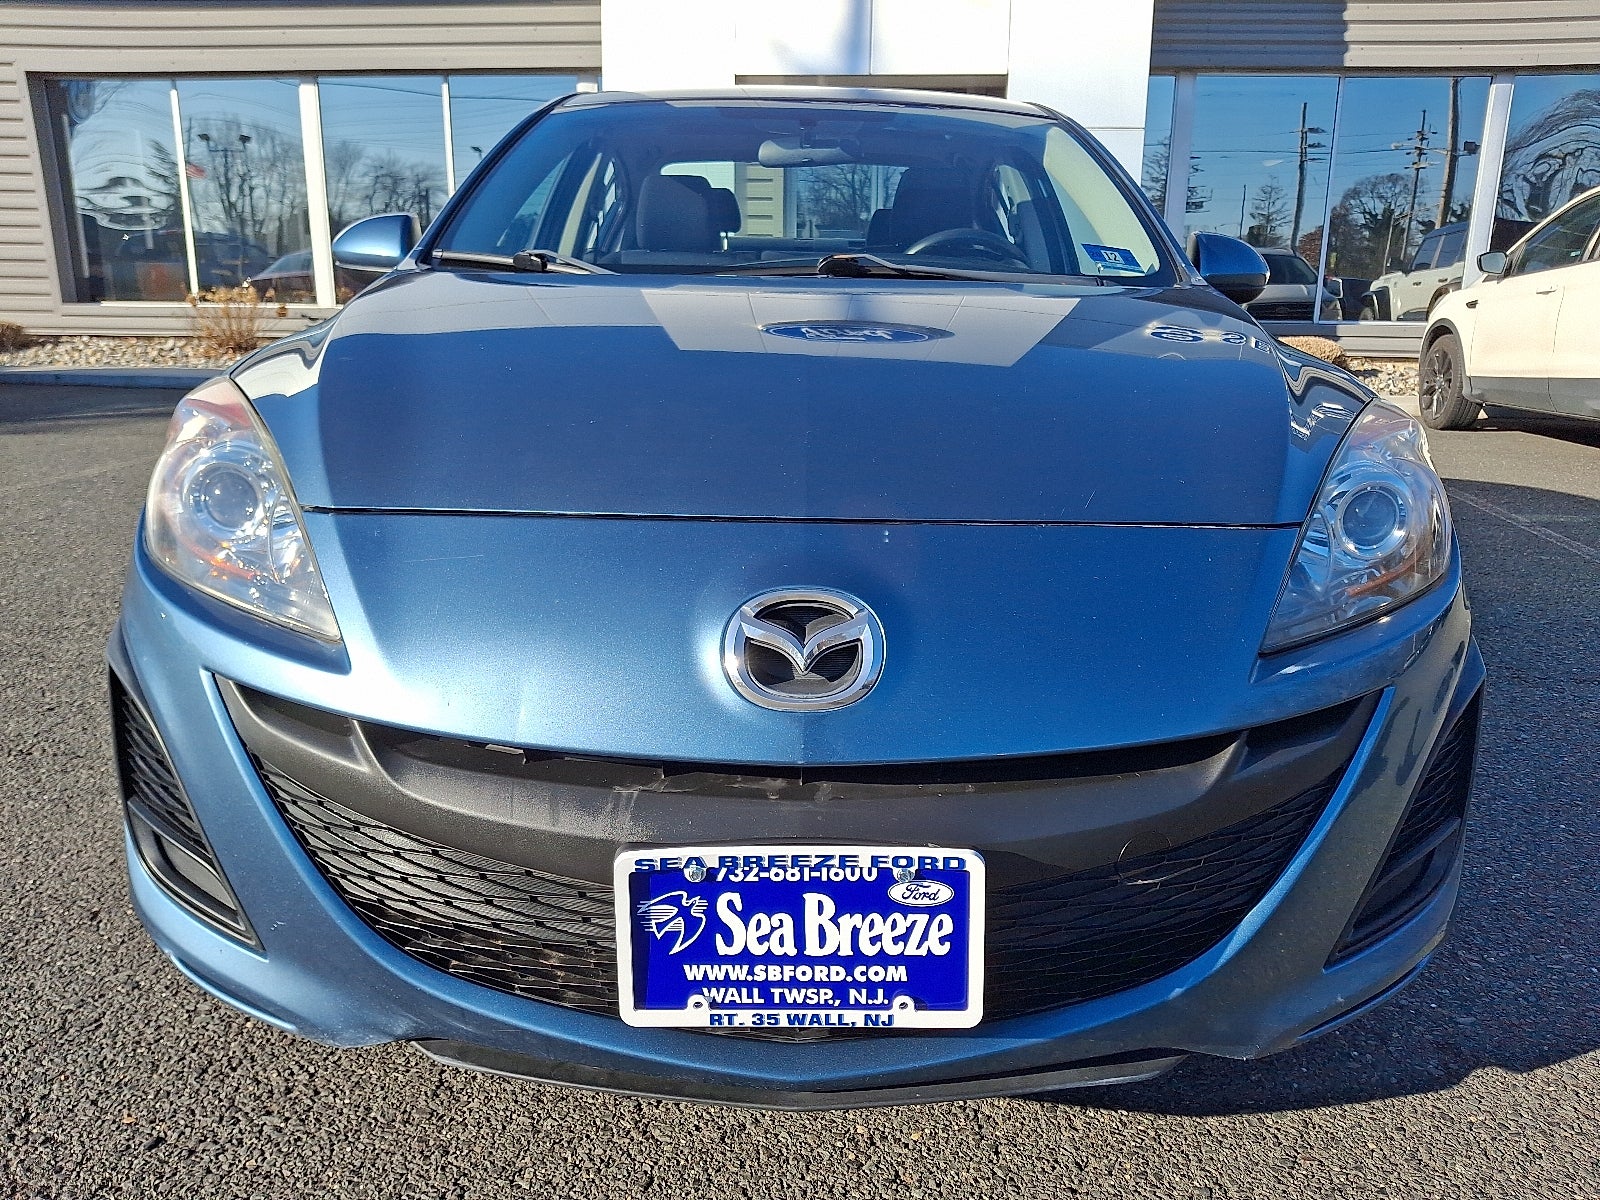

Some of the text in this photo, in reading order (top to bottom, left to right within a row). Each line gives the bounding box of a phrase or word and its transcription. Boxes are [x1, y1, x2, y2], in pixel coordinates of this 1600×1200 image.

[634, 855, 966, 873] SEA BREEZE FORD
[901, 883, 940, 901] Ford
[715, 891, 954, 957] Sea Breeze
[683, 964, 908, 982] WWW.SBFORD.COM
[702, 987, 764, 1005] WALL
[849, 988, 889, 1005] N.J.
[709, 1013, 895, 1028] RT. 35 WALL, NJ
